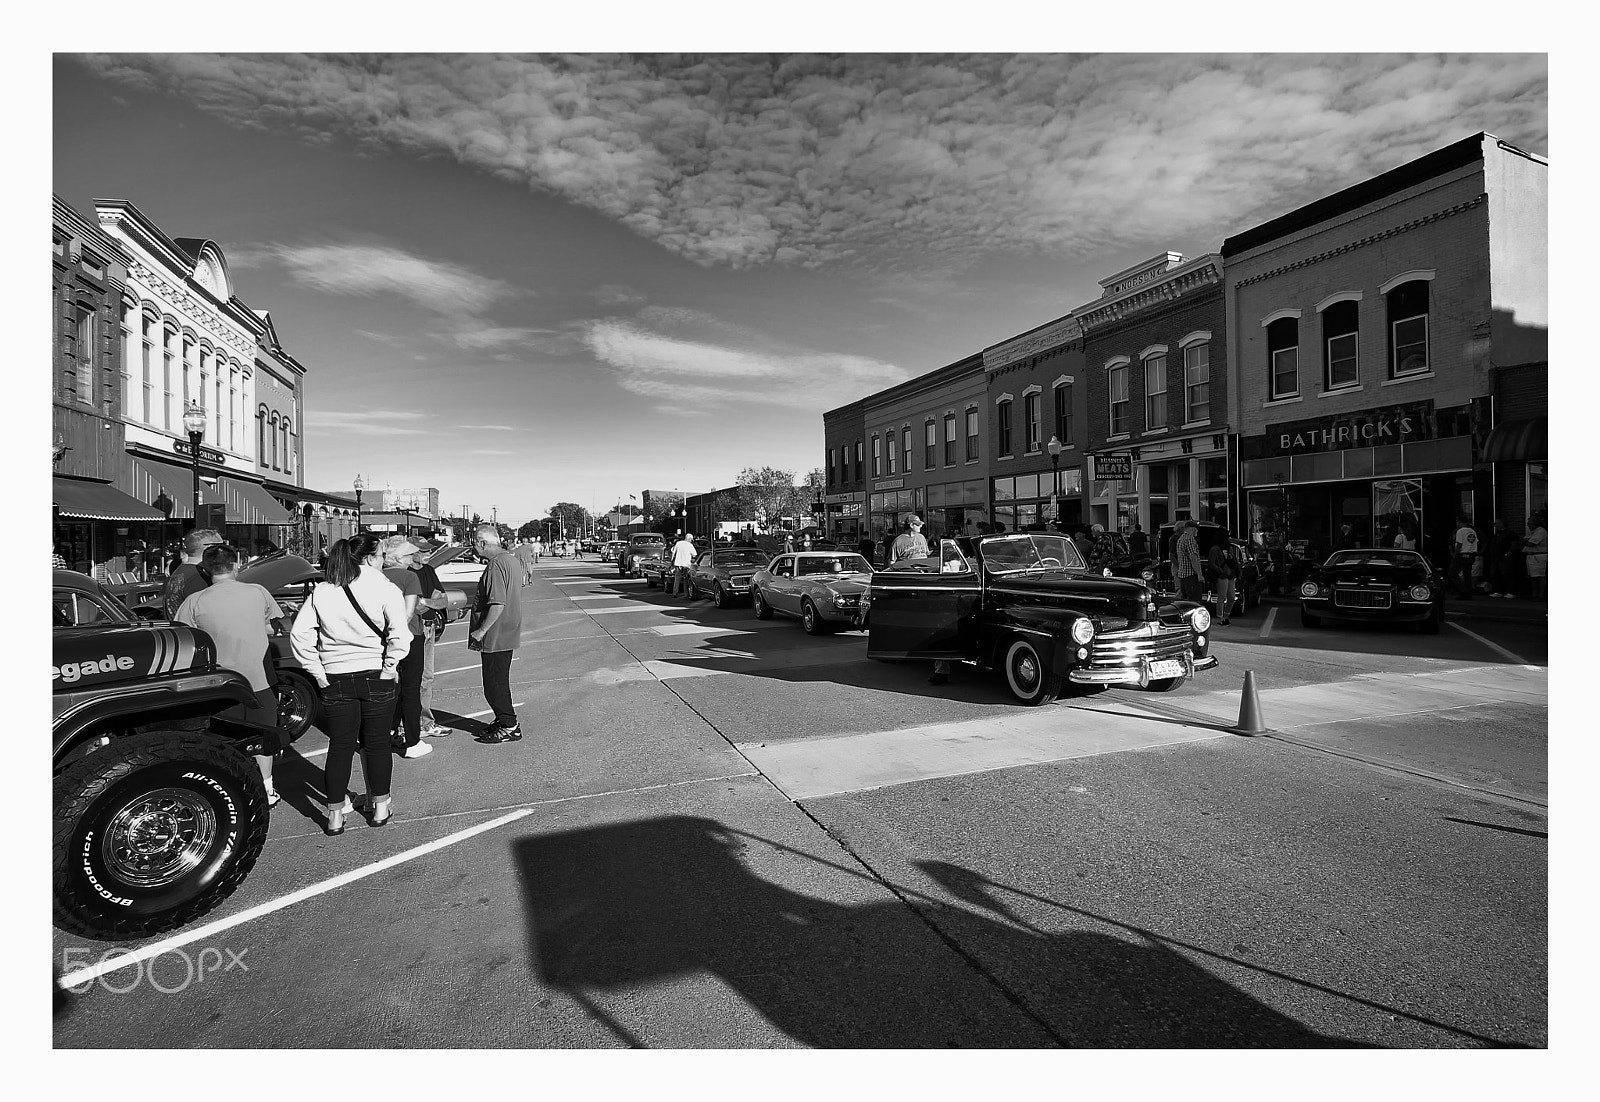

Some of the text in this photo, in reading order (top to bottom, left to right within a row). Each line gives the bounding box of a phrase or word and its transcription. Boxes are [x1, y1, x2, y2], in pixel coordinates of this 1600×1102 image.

[1280, 417, 1413, 449] BATHRICK'S
[188, 446, 217, 461] EORIUM
[1097, 463, 1130, 473] MEATS
[181, 772, 238, 825] All-Terrain
[82, 831, 134, 907] BFGoodrich
